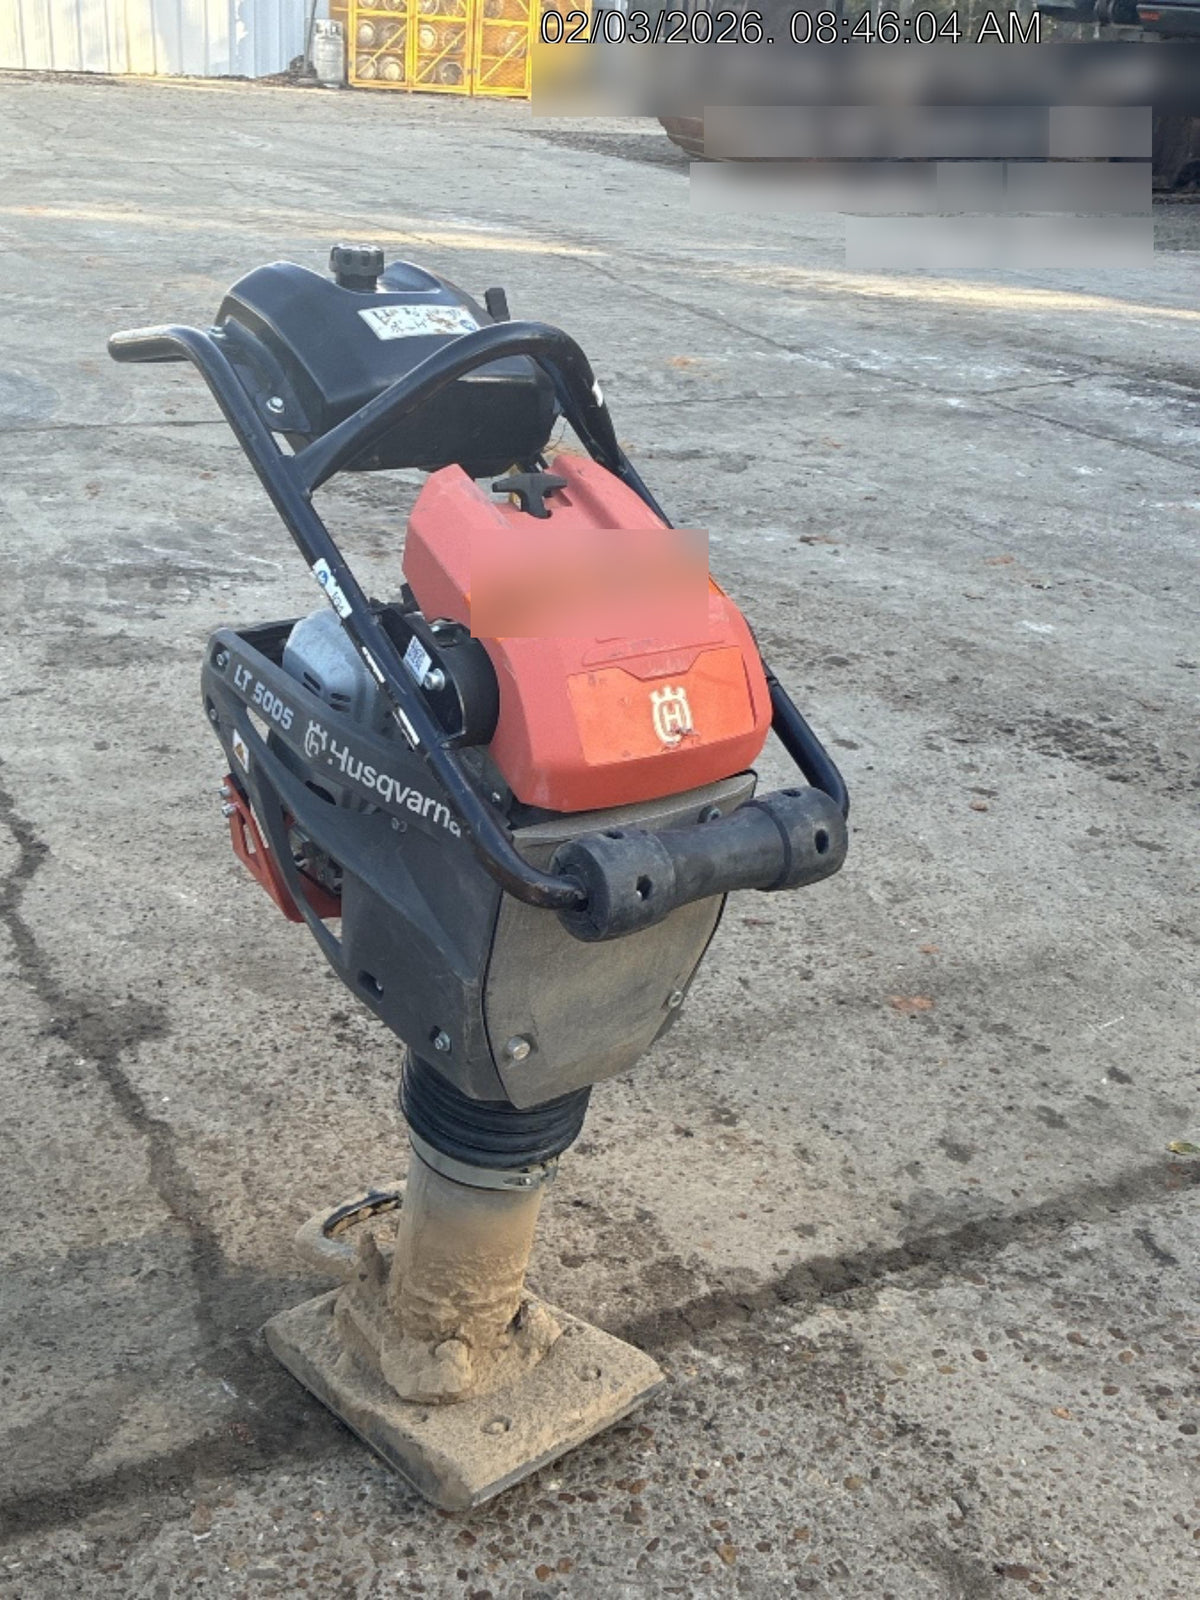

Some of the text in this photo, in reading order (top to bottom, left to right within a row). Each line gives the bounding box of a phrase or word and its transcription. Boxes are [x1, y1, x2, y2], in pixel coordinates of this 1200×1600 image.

[233, 664, 295, 730] LT 5005
[327, 739, 461, 838] Husqvarna
